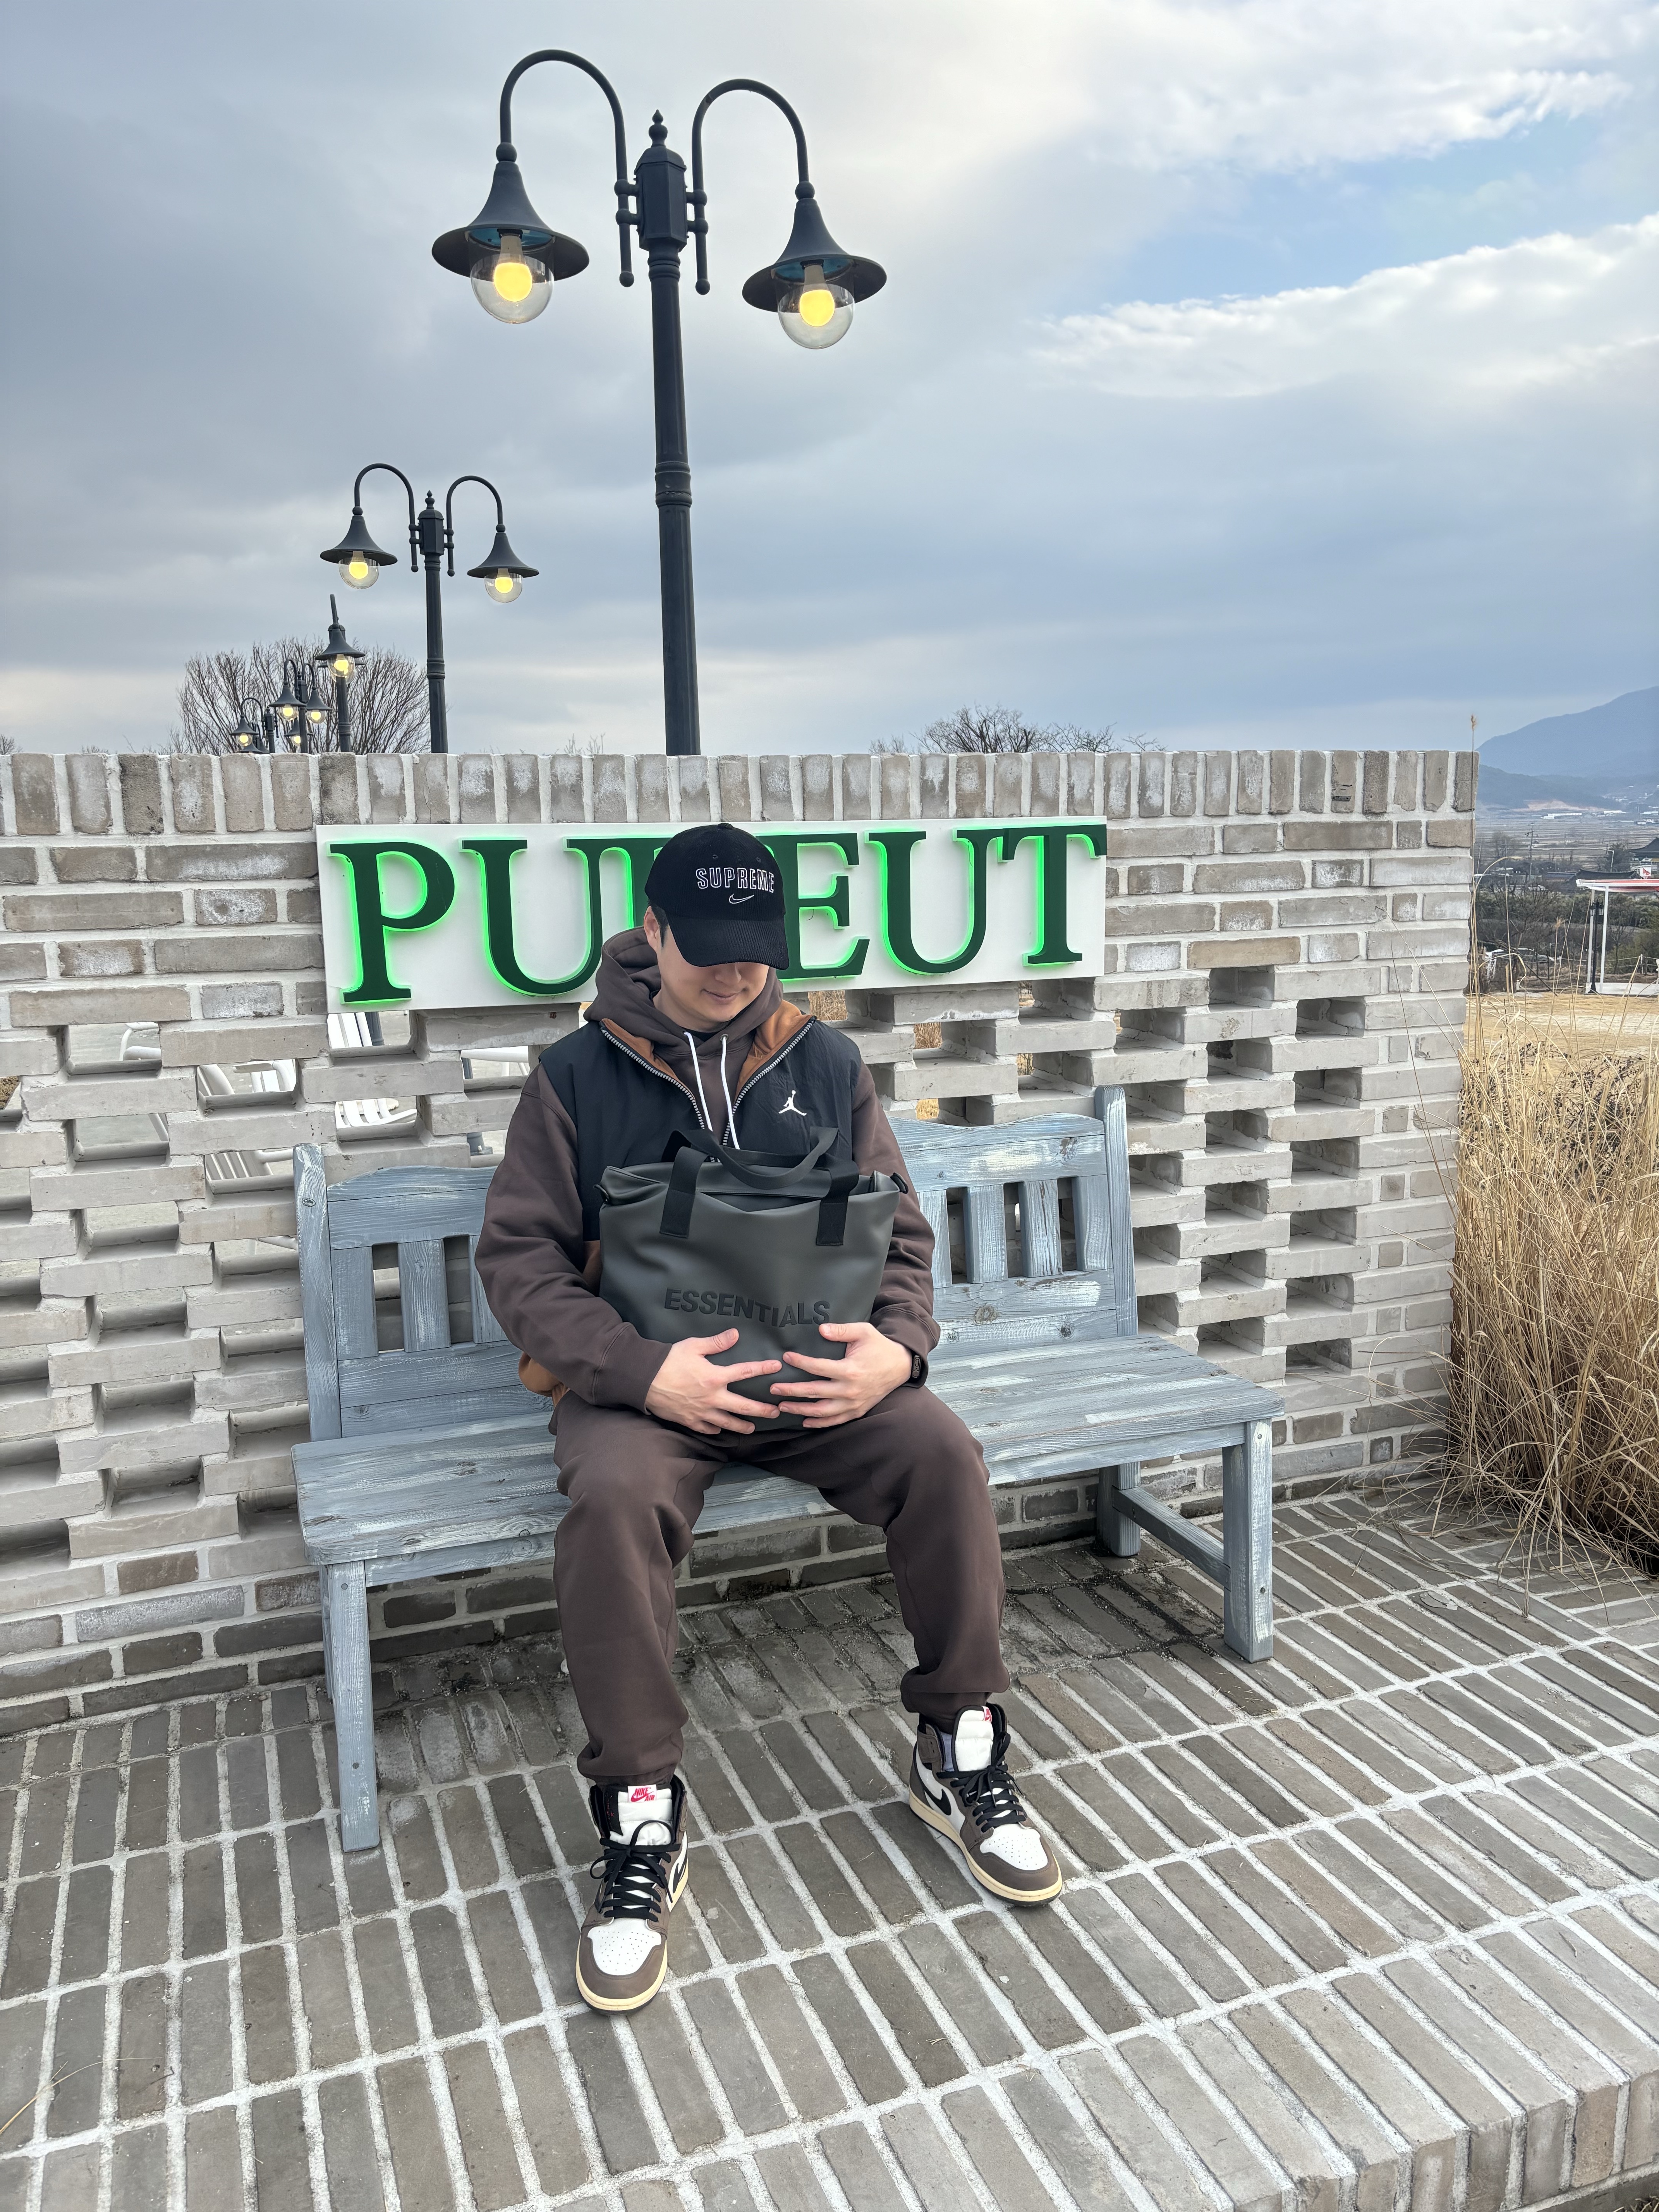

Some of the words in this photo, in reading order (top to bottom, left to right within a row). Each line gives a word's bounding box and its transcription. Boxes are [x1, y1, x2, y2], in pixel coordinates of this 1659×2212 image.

[696, 867, 774, 893] SUPREME
[328, 823, 1108, 1003] PUEUT
[664, 1288, 830, 1327] ESSENTIALS
[634, 1787, 649, 1798] NIKE
